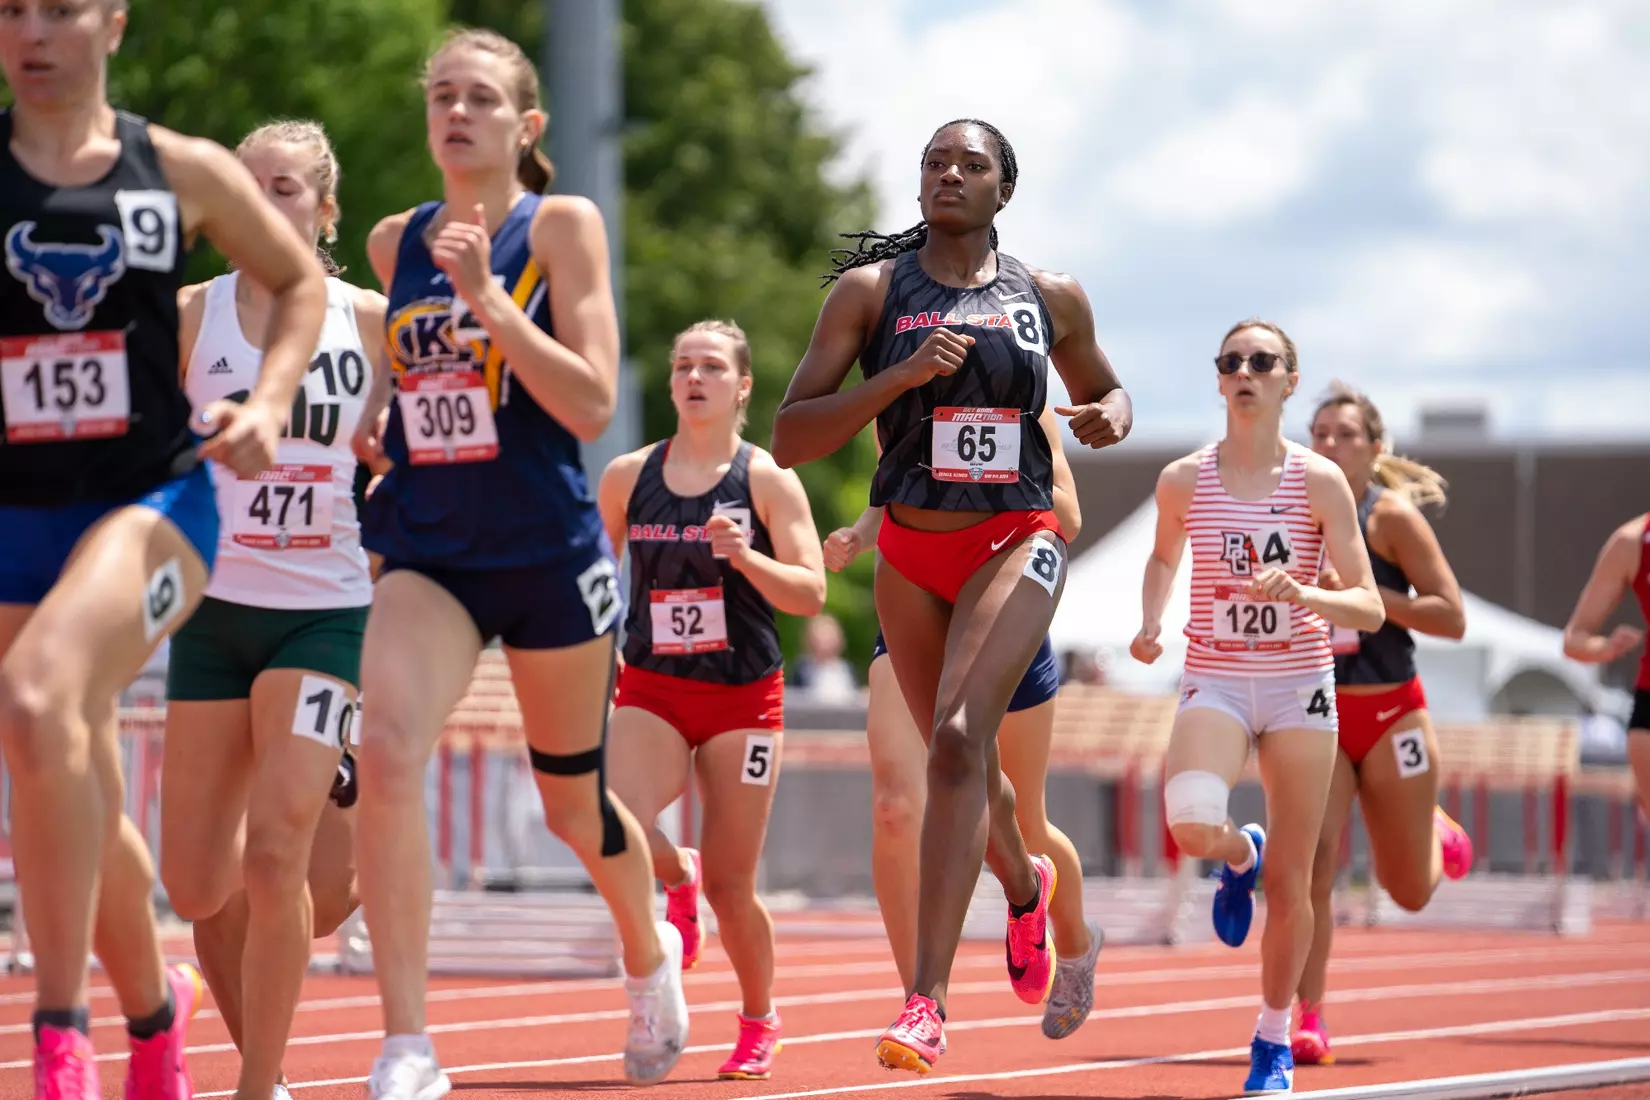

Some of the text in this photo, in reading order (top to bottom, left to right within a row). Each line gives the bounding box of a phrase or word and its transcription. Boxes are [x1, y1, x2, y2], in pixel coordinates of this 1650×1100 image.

[131, 207, 166, 255] 9
[895, 312, 1013, 335] BALL STA
[1013, 309, 1039, 344] 8
[24, 359, 106, 411] 153
[308, 350, 365, 396] 10
[416, 394, 475, 438] 309
[958, 425, 996, 462] 65
[248, 485, 314, 526] 471
[629, 524, 712, 541] BALL ST
[1263, 532, 1290, 564] 4
[1031, 547, 1058, 582] 8
[671, 605, 704, 636] 52
[1226, 603, 1277, 635] 120
[1307, 688, 1330, 718] 4
[747, 745, 769, 779] 5
[1400, 738, 1422, 768] 3
